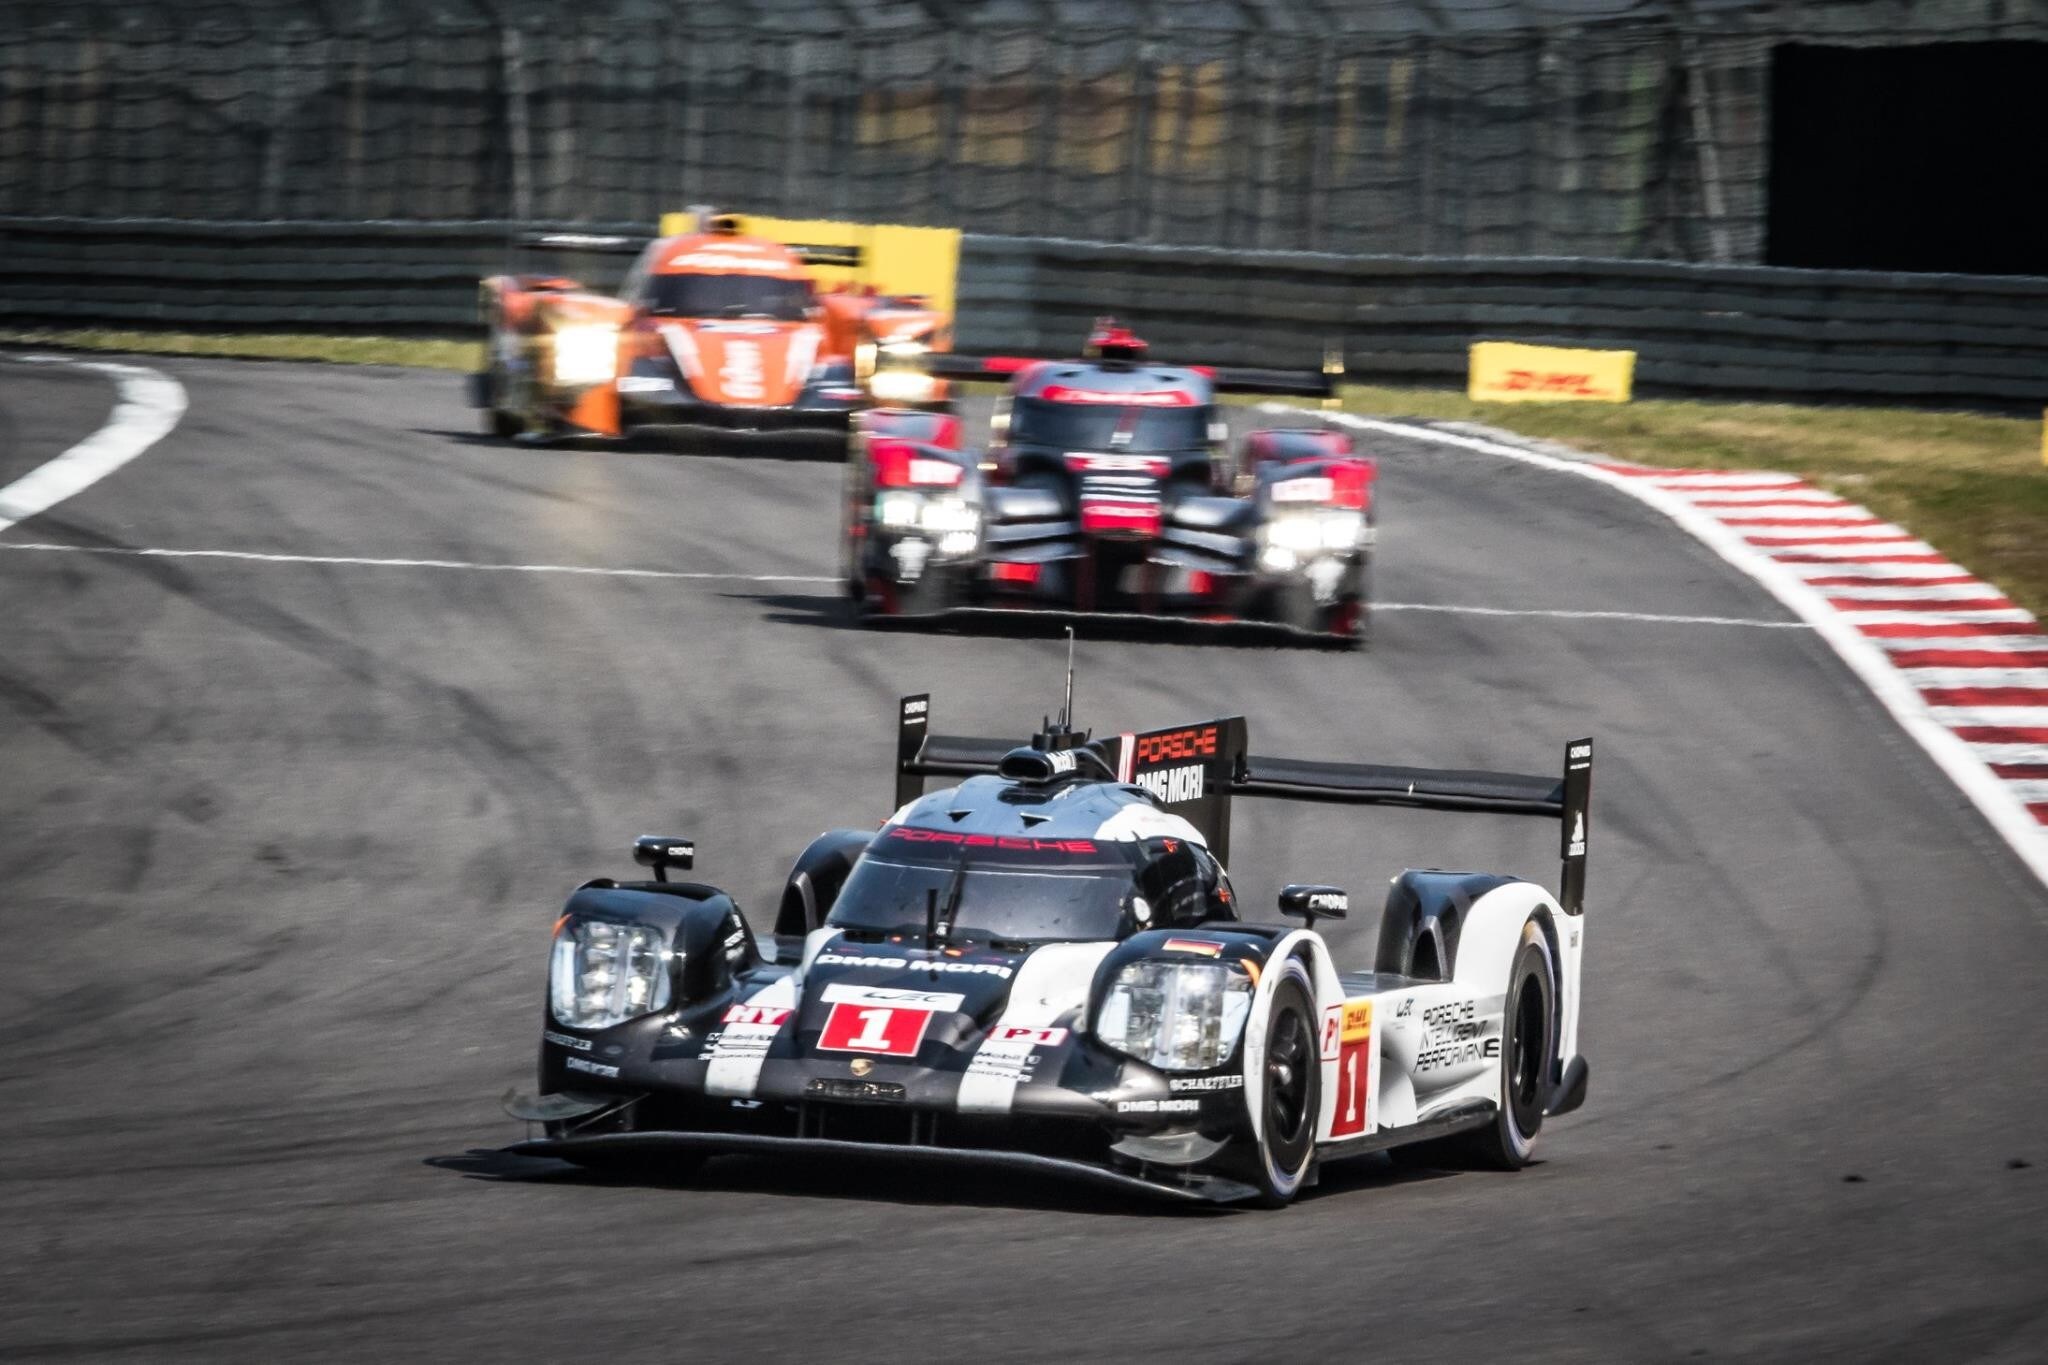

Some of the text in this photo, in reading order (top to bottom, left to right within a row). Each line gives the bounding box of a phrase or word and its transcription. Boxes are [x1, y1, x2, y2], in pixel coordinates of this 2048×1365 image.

[1137, 727, 1217, 764] PORSCHE
[1167, 764, 1204, 804] MORI
[889, 828, 1097, 853] PORSCHE
[816, 954, 1014, 979] DMG MORI
[722, 1004, 783, 1023] HY
[1423, 1000, 1474, 1026] PORSCHE
[847, 1009, 894, 1049] 1
[1004, 1028, 1053, 1041] P1
[1324, 1017, 1340, 1053] P1
[1169, 1075, 1243, 1091] SCHAEFFLER
[1346, 1051, 1358, 1122] 1
[1117, 1099, 1199, 1113] DMG MORI
